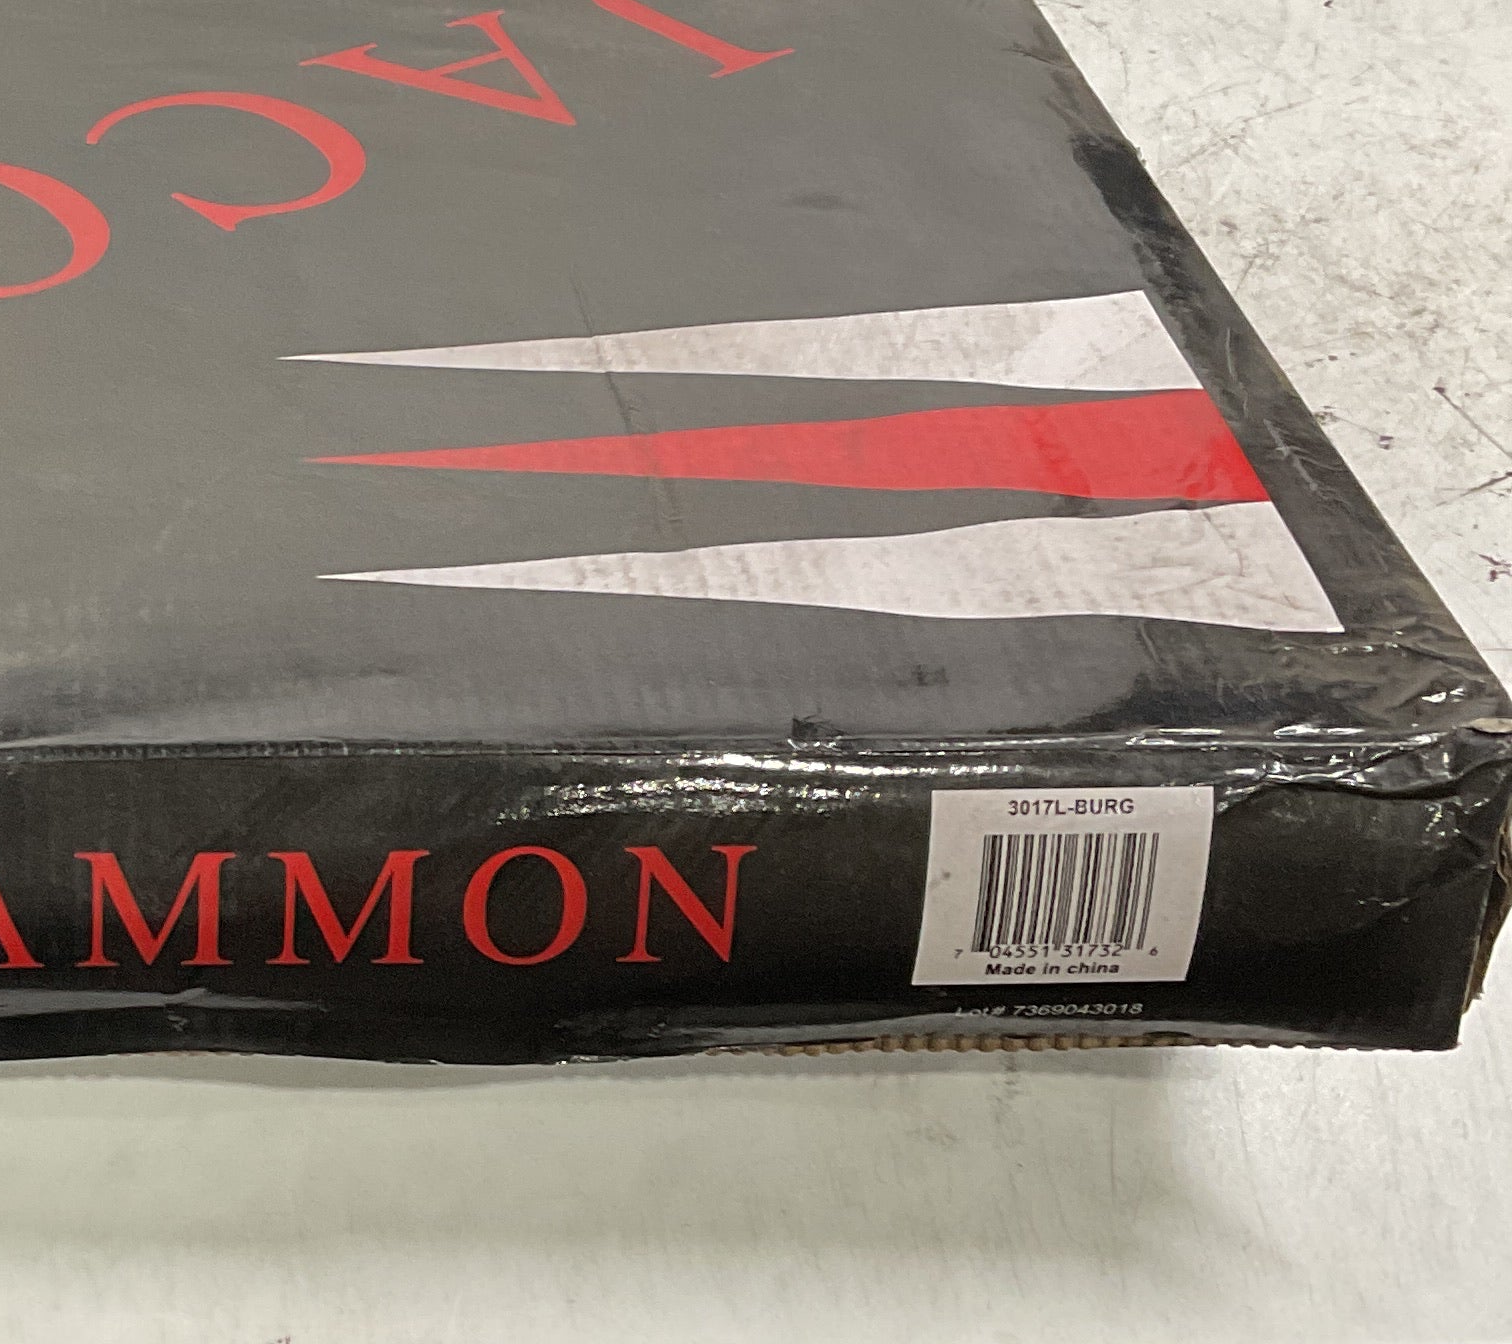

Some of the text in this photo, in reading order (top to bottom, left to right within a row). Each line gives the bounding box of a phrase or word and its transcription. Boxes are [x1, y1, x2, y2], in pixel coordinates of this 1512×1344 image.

[1007, 797, 1136, 816] 3017L-BURG
[989, 945, 1050, 959] 04551
[1060, 944, 1124, 958] 31732
[984, 962, 1120, 976] Made in china
[1012, 1003, 1144, 1017] 7369043018
